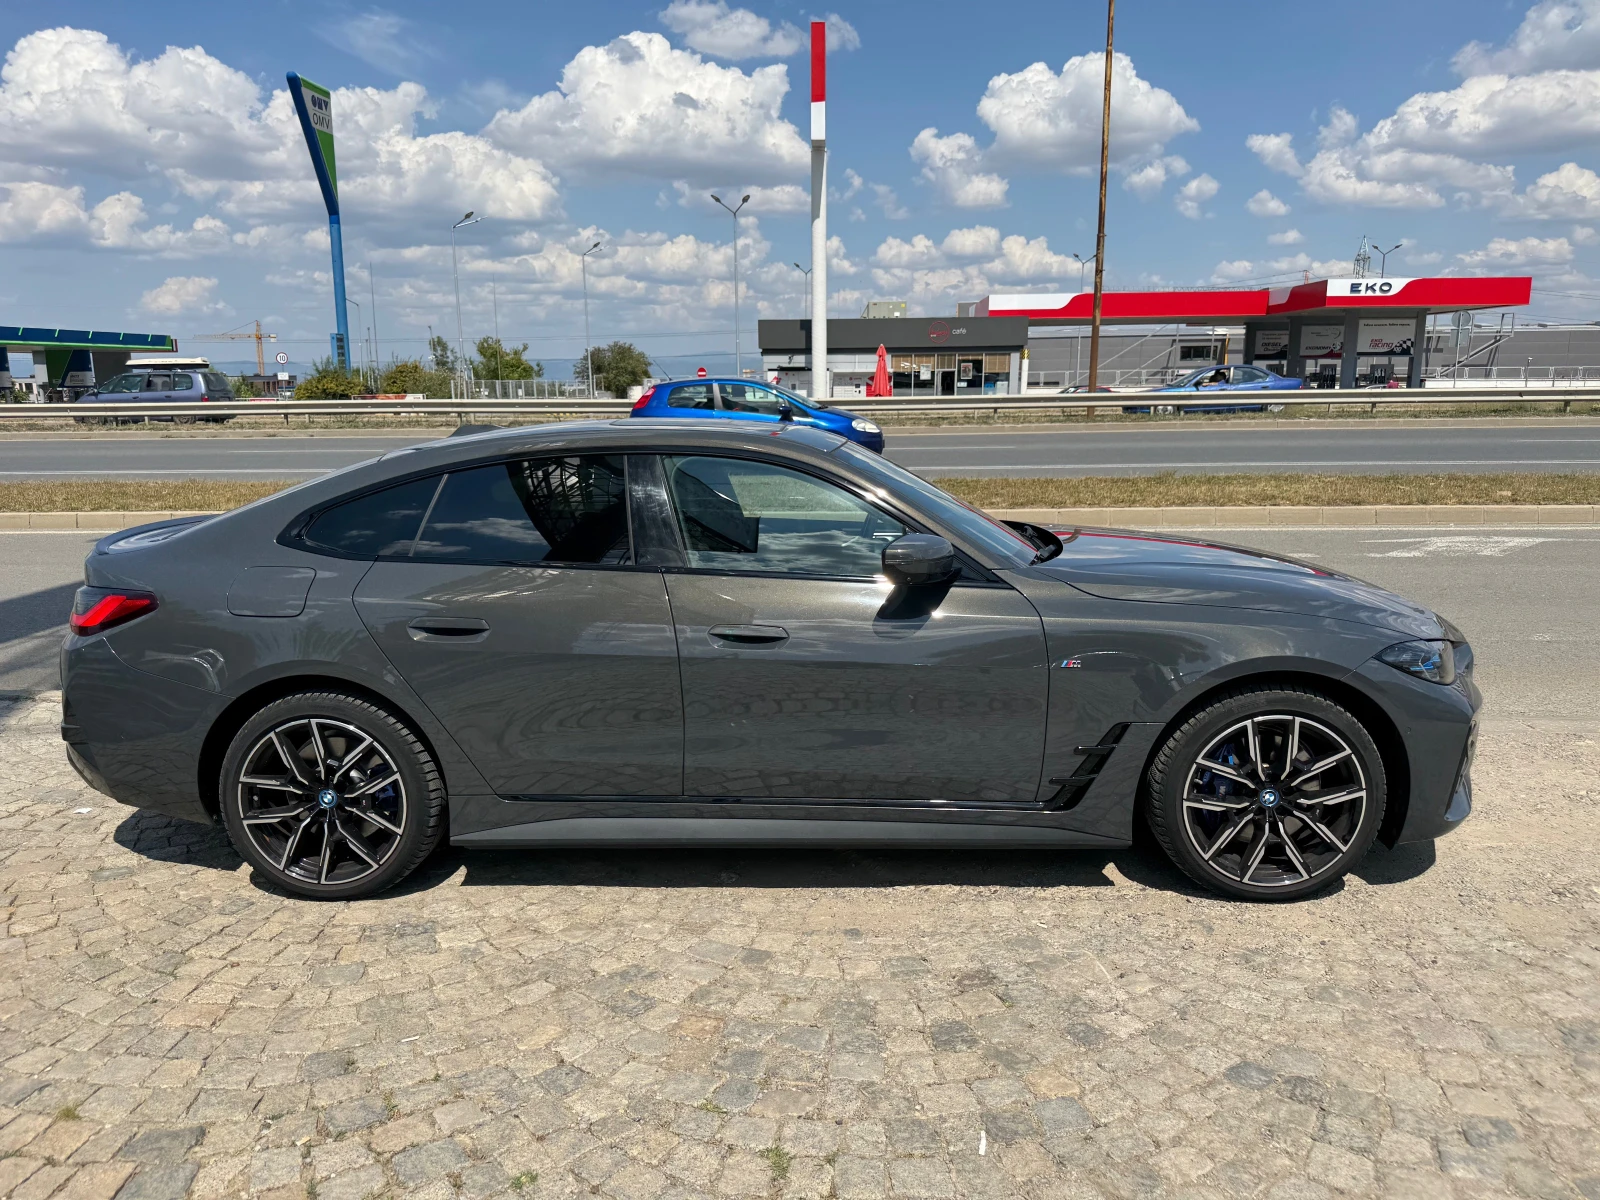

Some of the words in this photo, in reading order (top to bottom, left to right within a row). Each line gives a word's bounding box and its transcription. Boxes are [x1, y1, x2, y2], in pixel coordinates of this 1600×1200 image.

[312, 112, 330, 130] OMV
[1350, 282, 1392, 294] EKO
[952, 327, 967, 335] café
